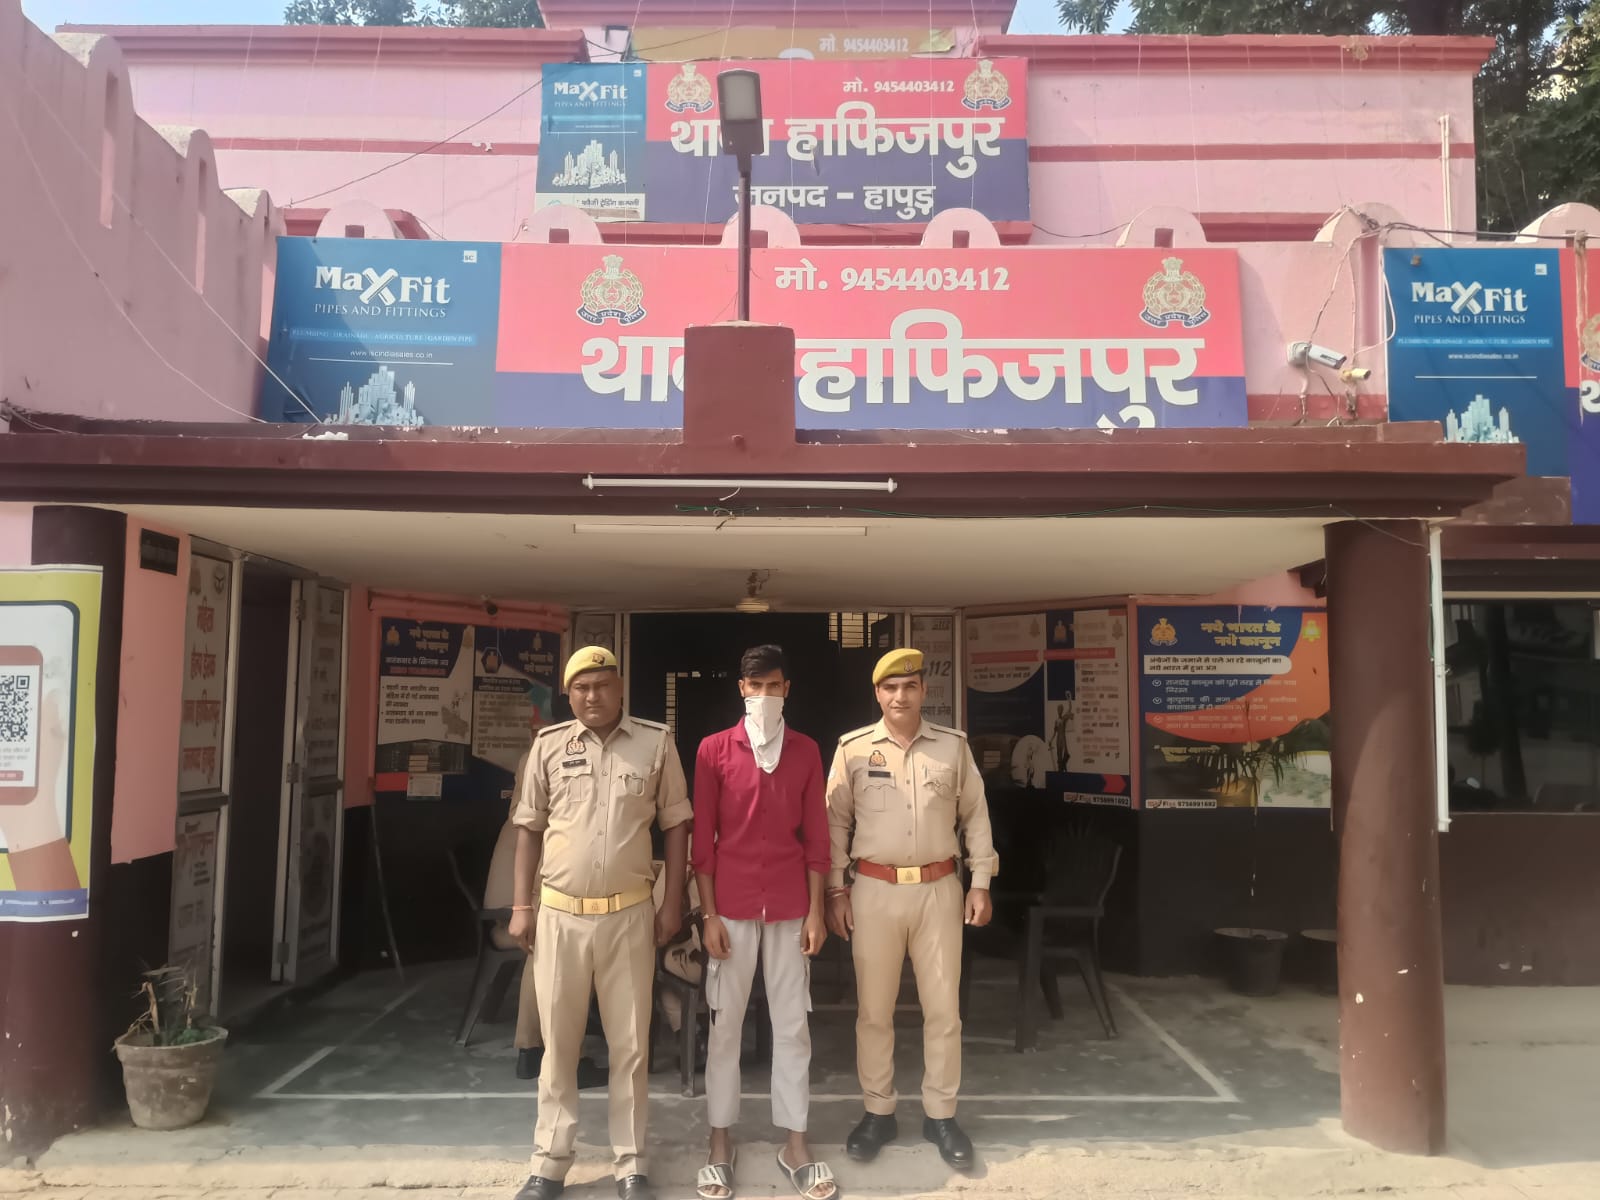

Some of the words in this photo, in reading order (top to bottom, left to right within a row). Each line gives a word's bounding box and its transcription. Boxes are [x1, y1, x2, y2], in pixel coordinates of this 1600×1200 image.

[843, 38, 909, 52] 9454403412
[874, 80, 954, 93] 9454403412
[775, 257, 829, 291] मो.
[840, 267, 1011, 292] 9454403412
[314, 303, 348, 315] PIPES
[351, 306, 381, 316] AND
[385, 307, 447, 318] FITTINGS
[1414, 315, 1442, 324] PIPES
[1446, 315, 1471, 324] AND
[1474, 315, 1526, 324] FITTINGS
